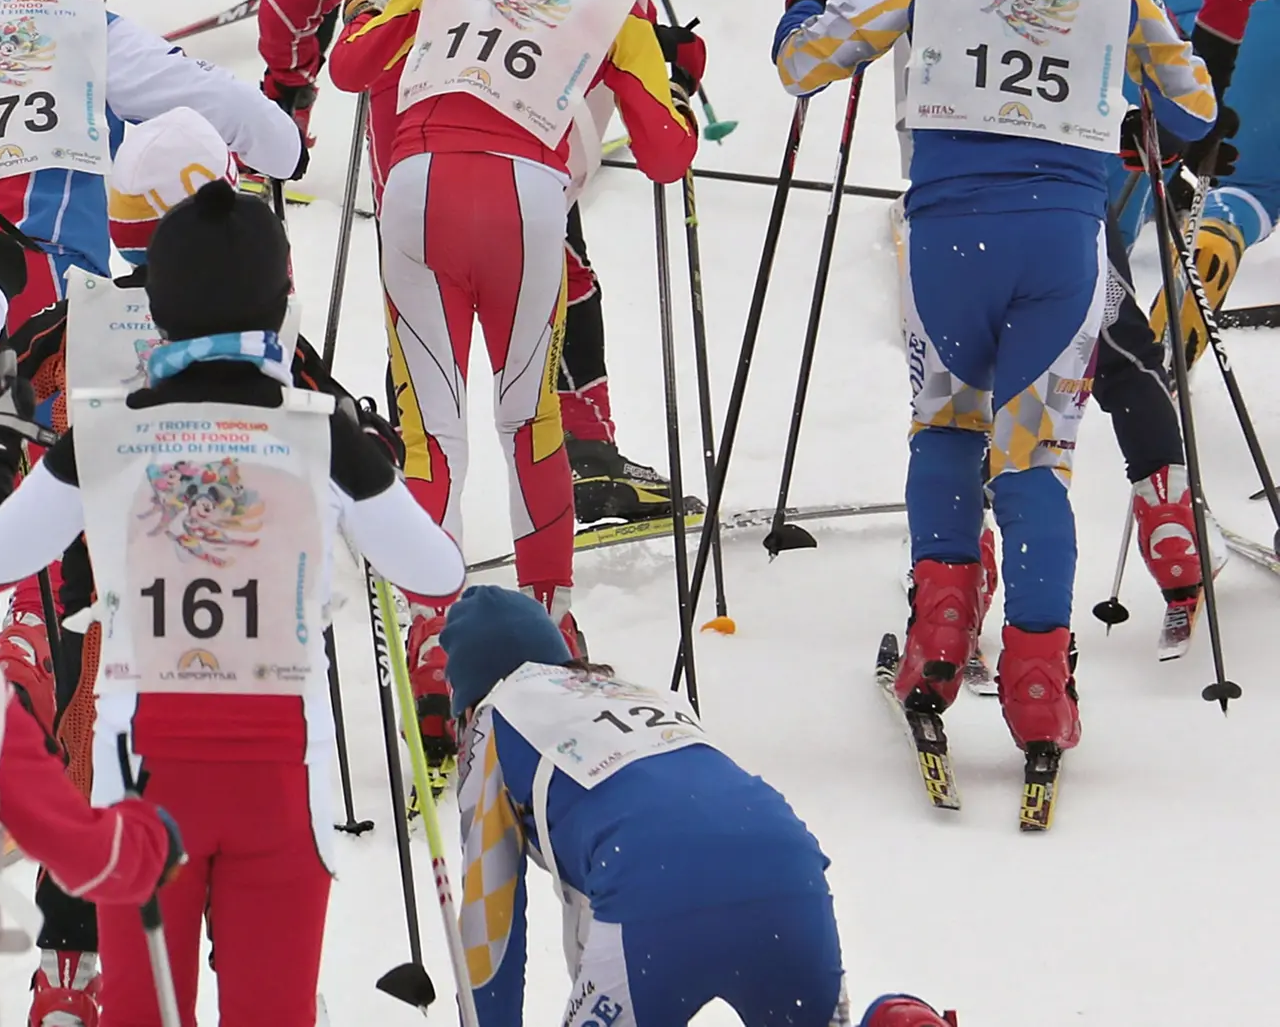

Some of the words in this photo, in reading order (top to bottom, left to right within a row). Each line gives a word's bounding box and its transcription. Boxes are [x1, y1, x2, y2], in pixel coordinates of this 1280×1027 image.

[445, 22, 543, 80] 116
[966, 44, 1069, 102] 125
[155, 433, 176, 443] SCI
[181, 433, 196, 443] DI
[201, 433, 250, 443] FONDO
[159, 420, 211, 431] TROFEO
[117, 443, 183, 454] CASTELLO
[188, 443, 202, 453] DI
[208, 443, 257, 454] FIEMME
[141, 578, 258, 639] 161
